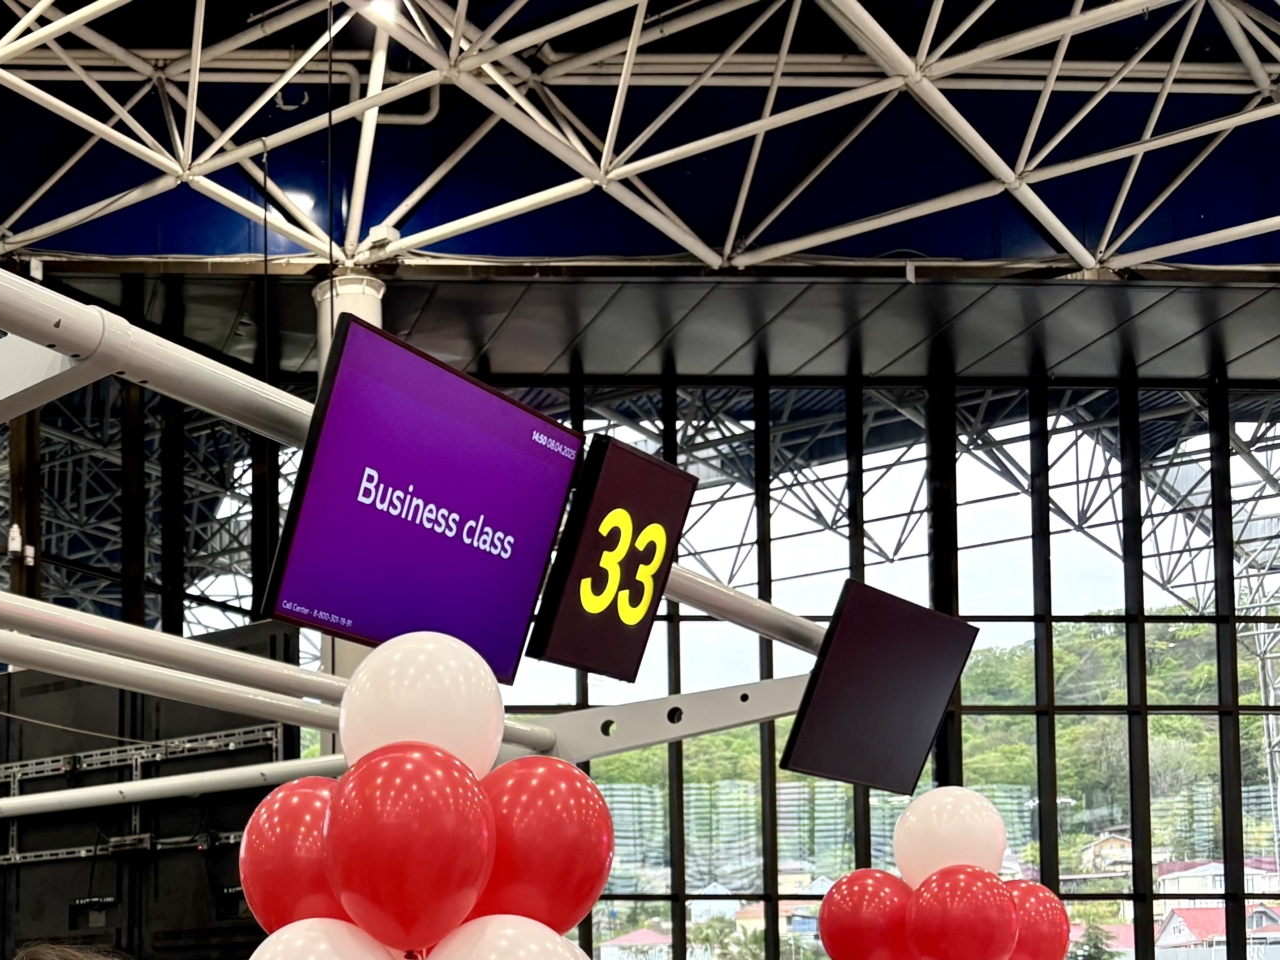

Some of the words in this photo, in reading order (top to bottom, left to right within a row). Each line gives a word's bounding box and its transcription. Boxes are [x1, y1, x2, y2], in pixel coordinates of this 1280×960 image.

[356, 466, 460, 538] Business
[462, 514, 515, 560] class
[282, 600, 293, 610] Call
[293, 603, 310, 615] Center
[579, 507, 667, 626] 33
